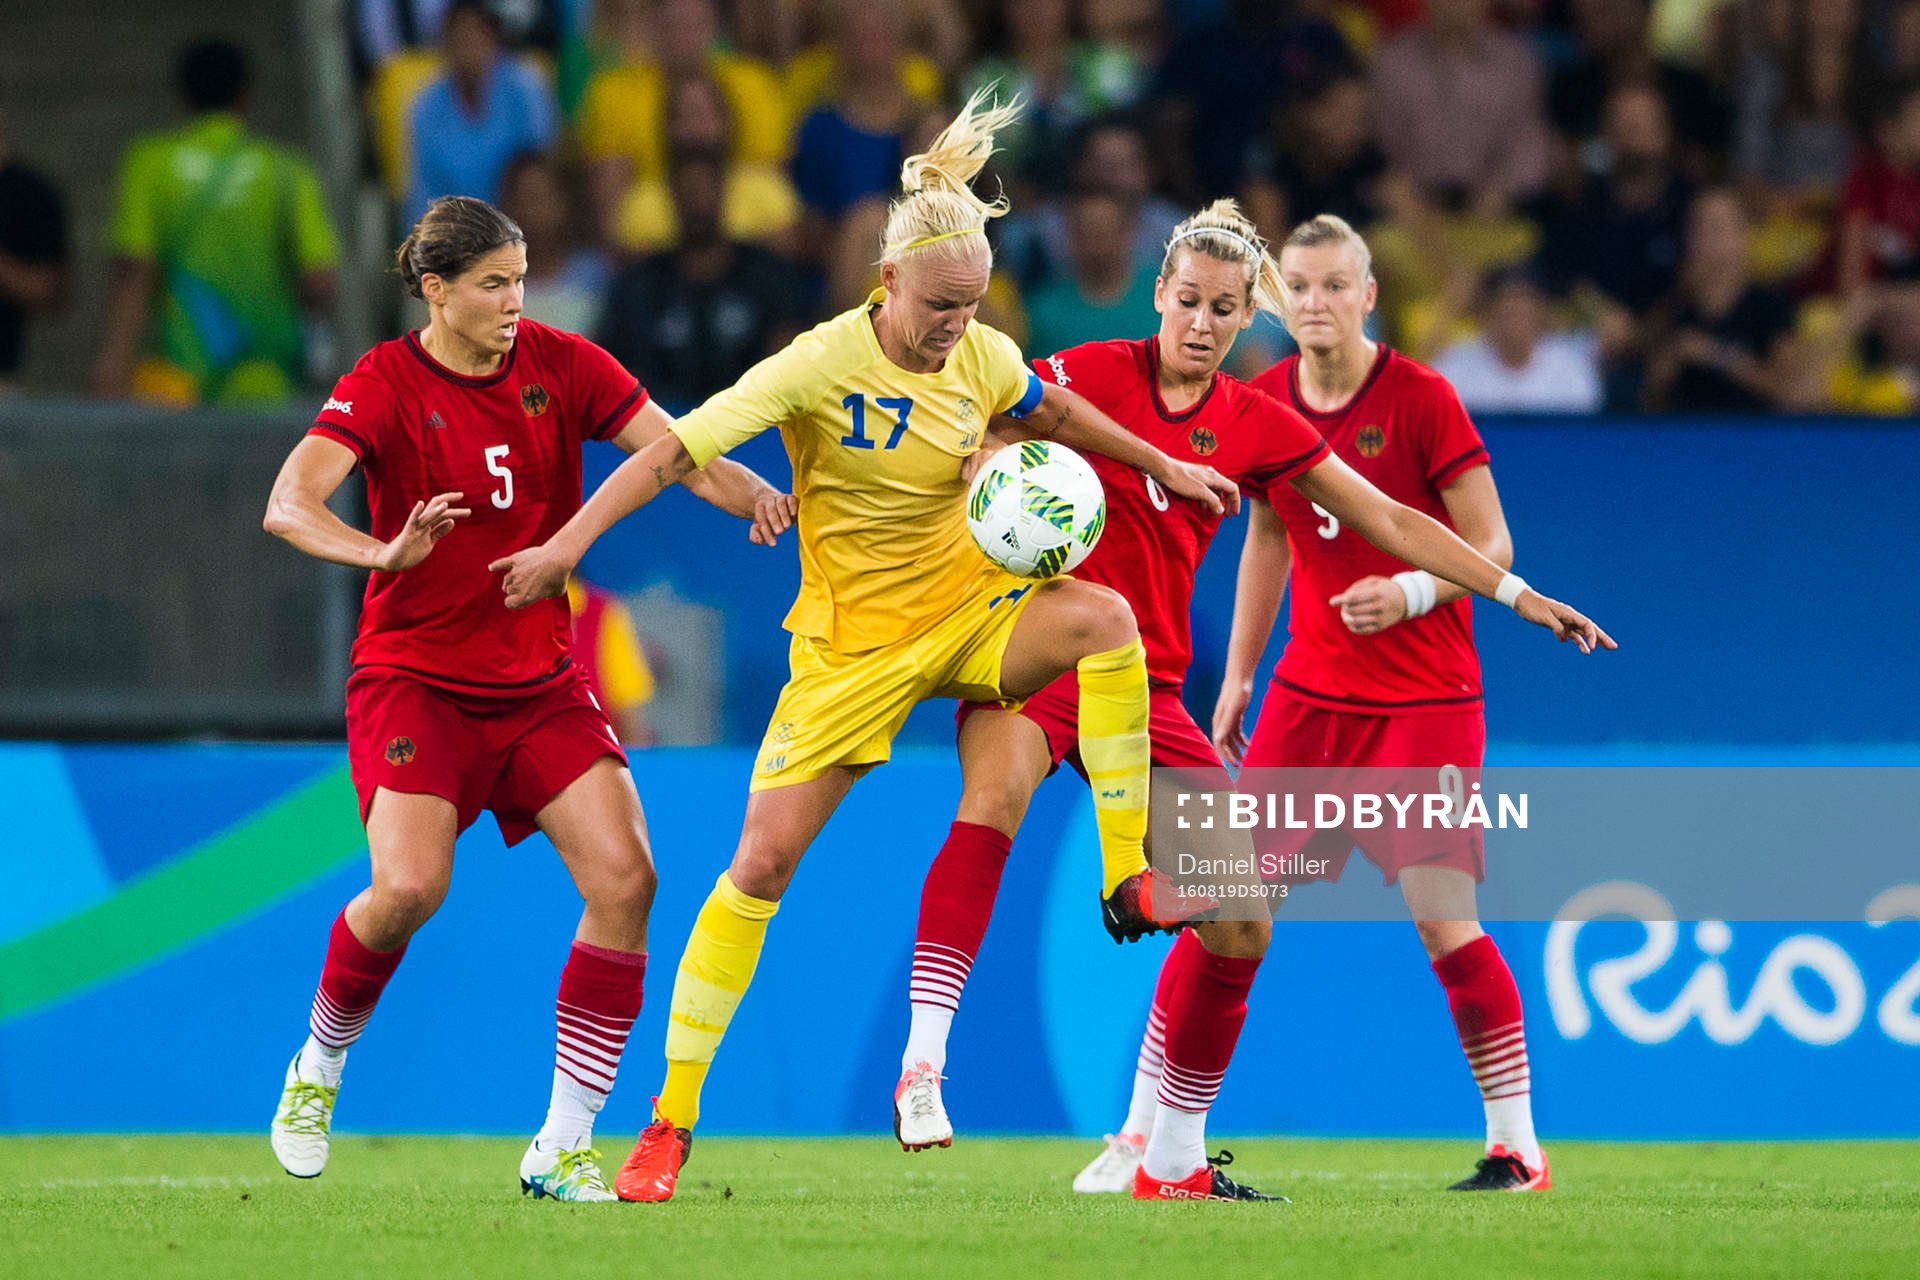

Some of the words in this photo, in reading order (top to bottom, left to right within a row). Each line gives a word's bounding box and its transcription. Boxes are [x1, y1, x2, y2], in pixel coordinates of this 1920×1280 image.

[841, 393, 914, 450] 17
[484, 443, 514, 510] 5
[1544, 880, 1867, 1046] Rio
